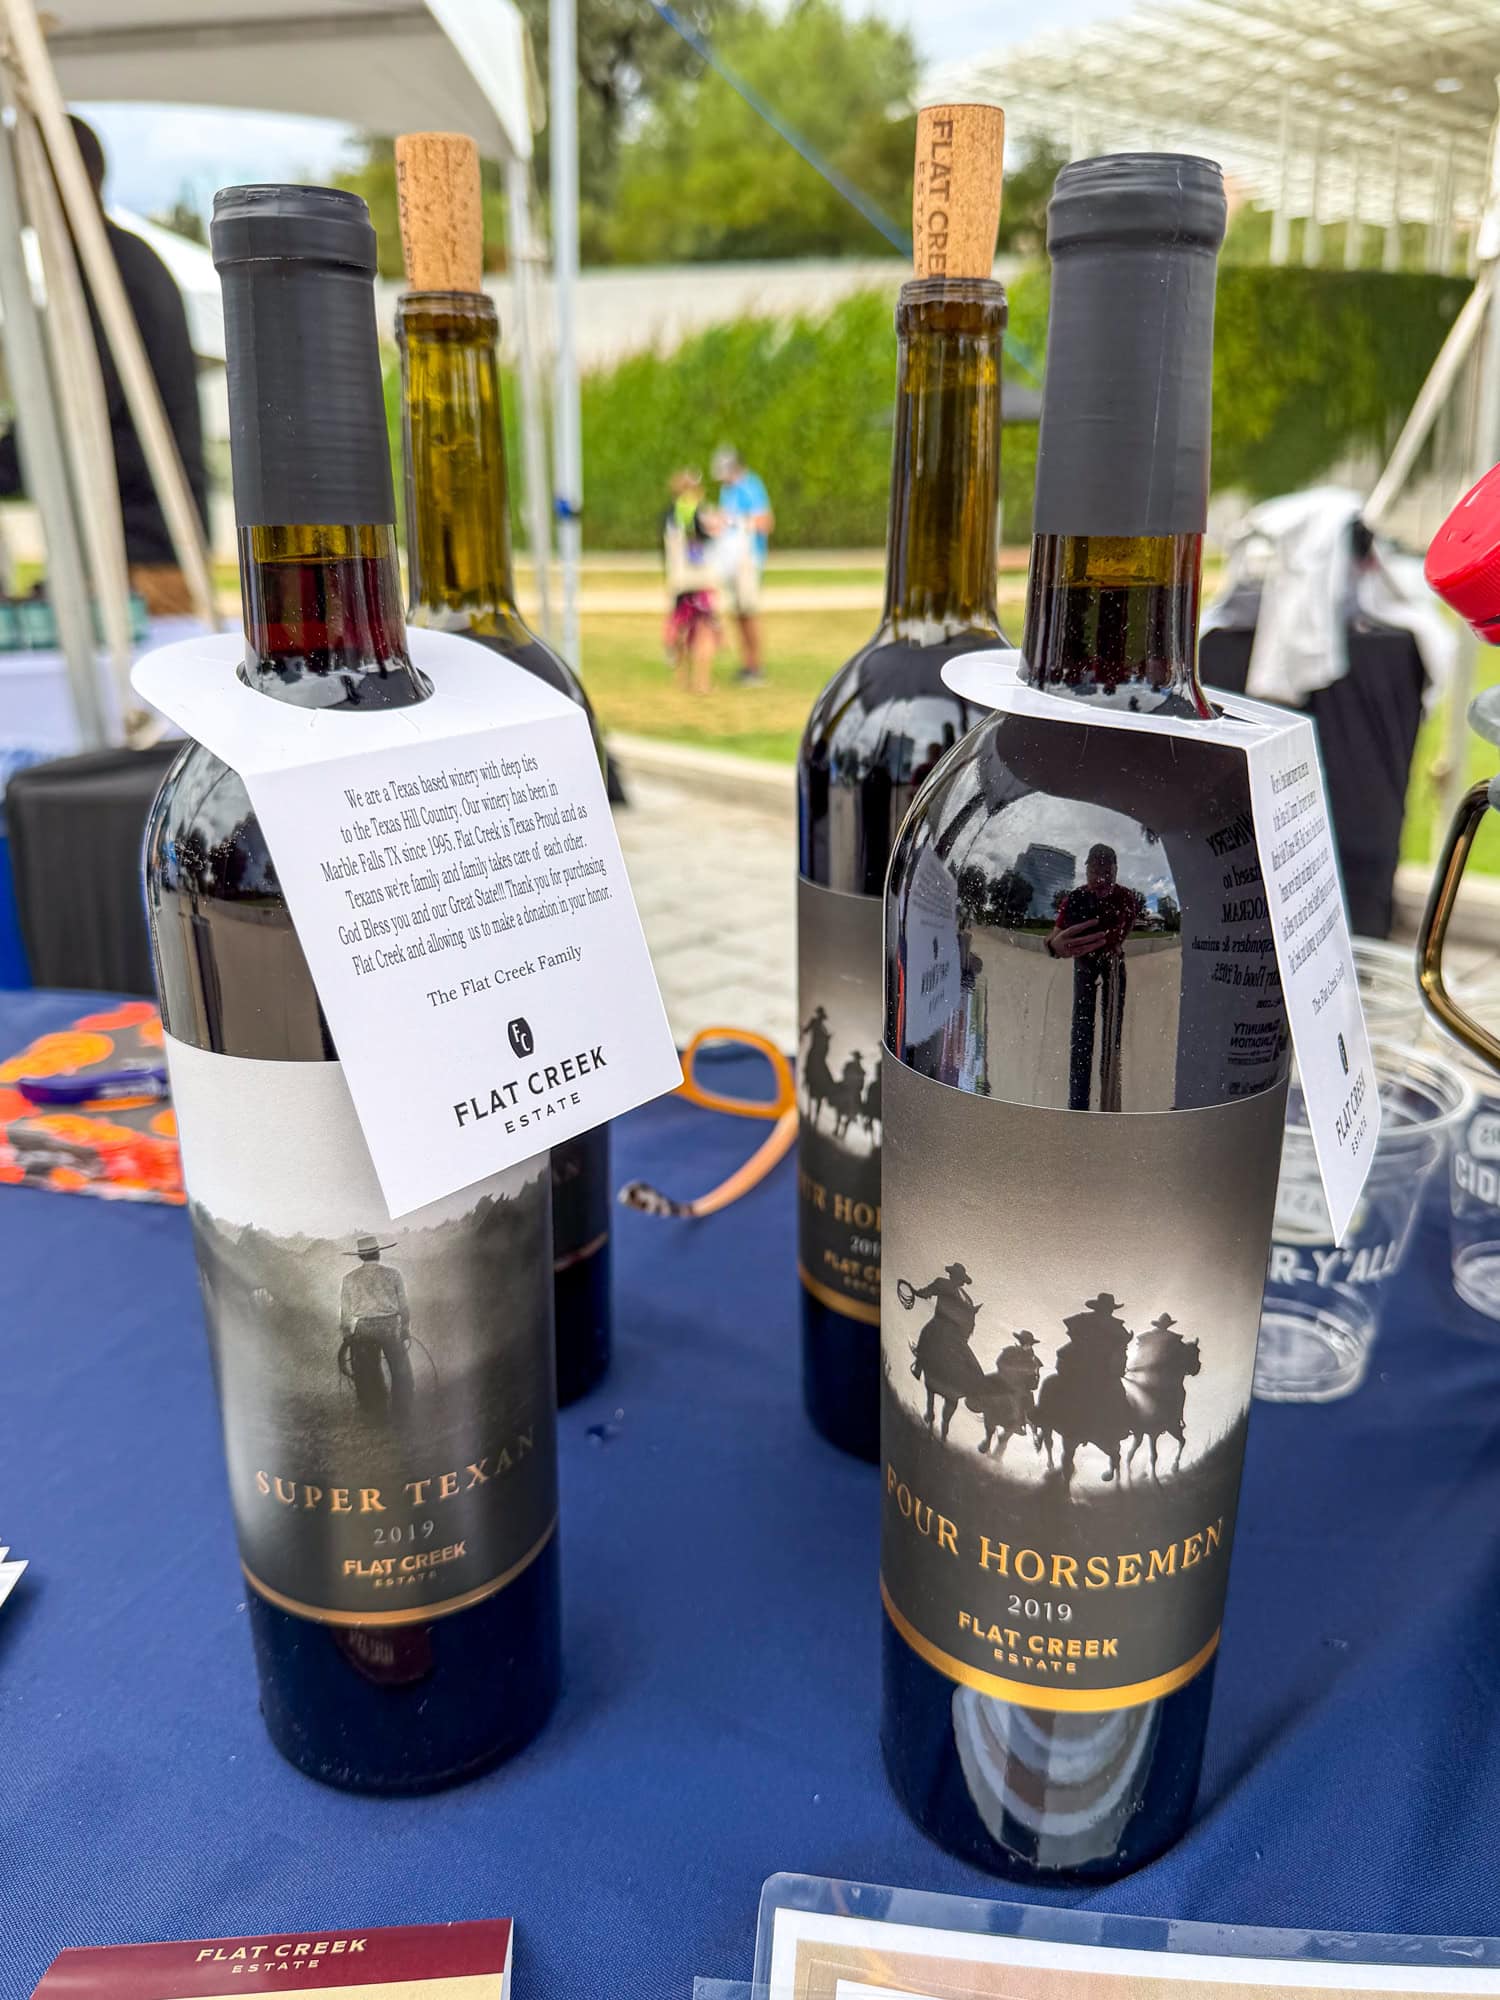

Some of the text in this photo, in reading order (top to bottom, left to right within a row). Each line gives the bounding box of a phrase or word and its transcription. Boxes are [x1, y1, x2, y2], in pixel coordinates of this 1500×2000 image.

[928, 120, 954, 277] FLAT CRE
[344, 753, 538, 808] We are a Texas based winery with deep ties
[340, 778, 559, 843] to the Texas Hill Country. Our winery has been in
[320, 803, 588, 882] Marble Falls TX since 1995. Flat Creek is Texas Proud and as
[345, 833, 587, 909] Texans we're family and family takes care of each other.
[338, 922, 362, 945] God
[360, 918, 391, 939] Bless
[390, 913, 411, 936] you
[411, 903, 431, 925] and
[431, 903, 448, 919] our
[448, 893, 476, 914] Great
[505, 875, 535, 898] Thank
[534, 874, 550, 895] you
[549, 868, 562, 886] for
[562, 856, 607, 887] purchasing
[352, 887, 612, 976] Flat Creek and allowing us to make a donation in your honor.
[427, 945, 582, 1008] The Flat Creek Family
[453, 1046, 608, 1128] FLAT CREEK
[505, 1092, 581, 1133] ESTATE
[1336, 1099, 1352, 1146] FLAT
[1270, 1239, 1400, 1288] R-Y'ALL
[255, 1426, 535, 1512] SUPER TEXAN
[373, 1519, 435, 1546] 2019
[888, 1463, 1224, 1590] FOUR HORSEMEN
[343, 1540, 467, 1577] FLAT CREEK
[374, 1570, 437, 1588] ESTATE
[958, 1610, 1119, 1658] FLAT CREEK
[1007, 1594, 1073, 1622] 2019
[994, 1648, 1077, 1673] ESTATE
[195, 1938, 368, 1964] FLAT CREEK
[231, 1959, 320, 1975] ESTATE
